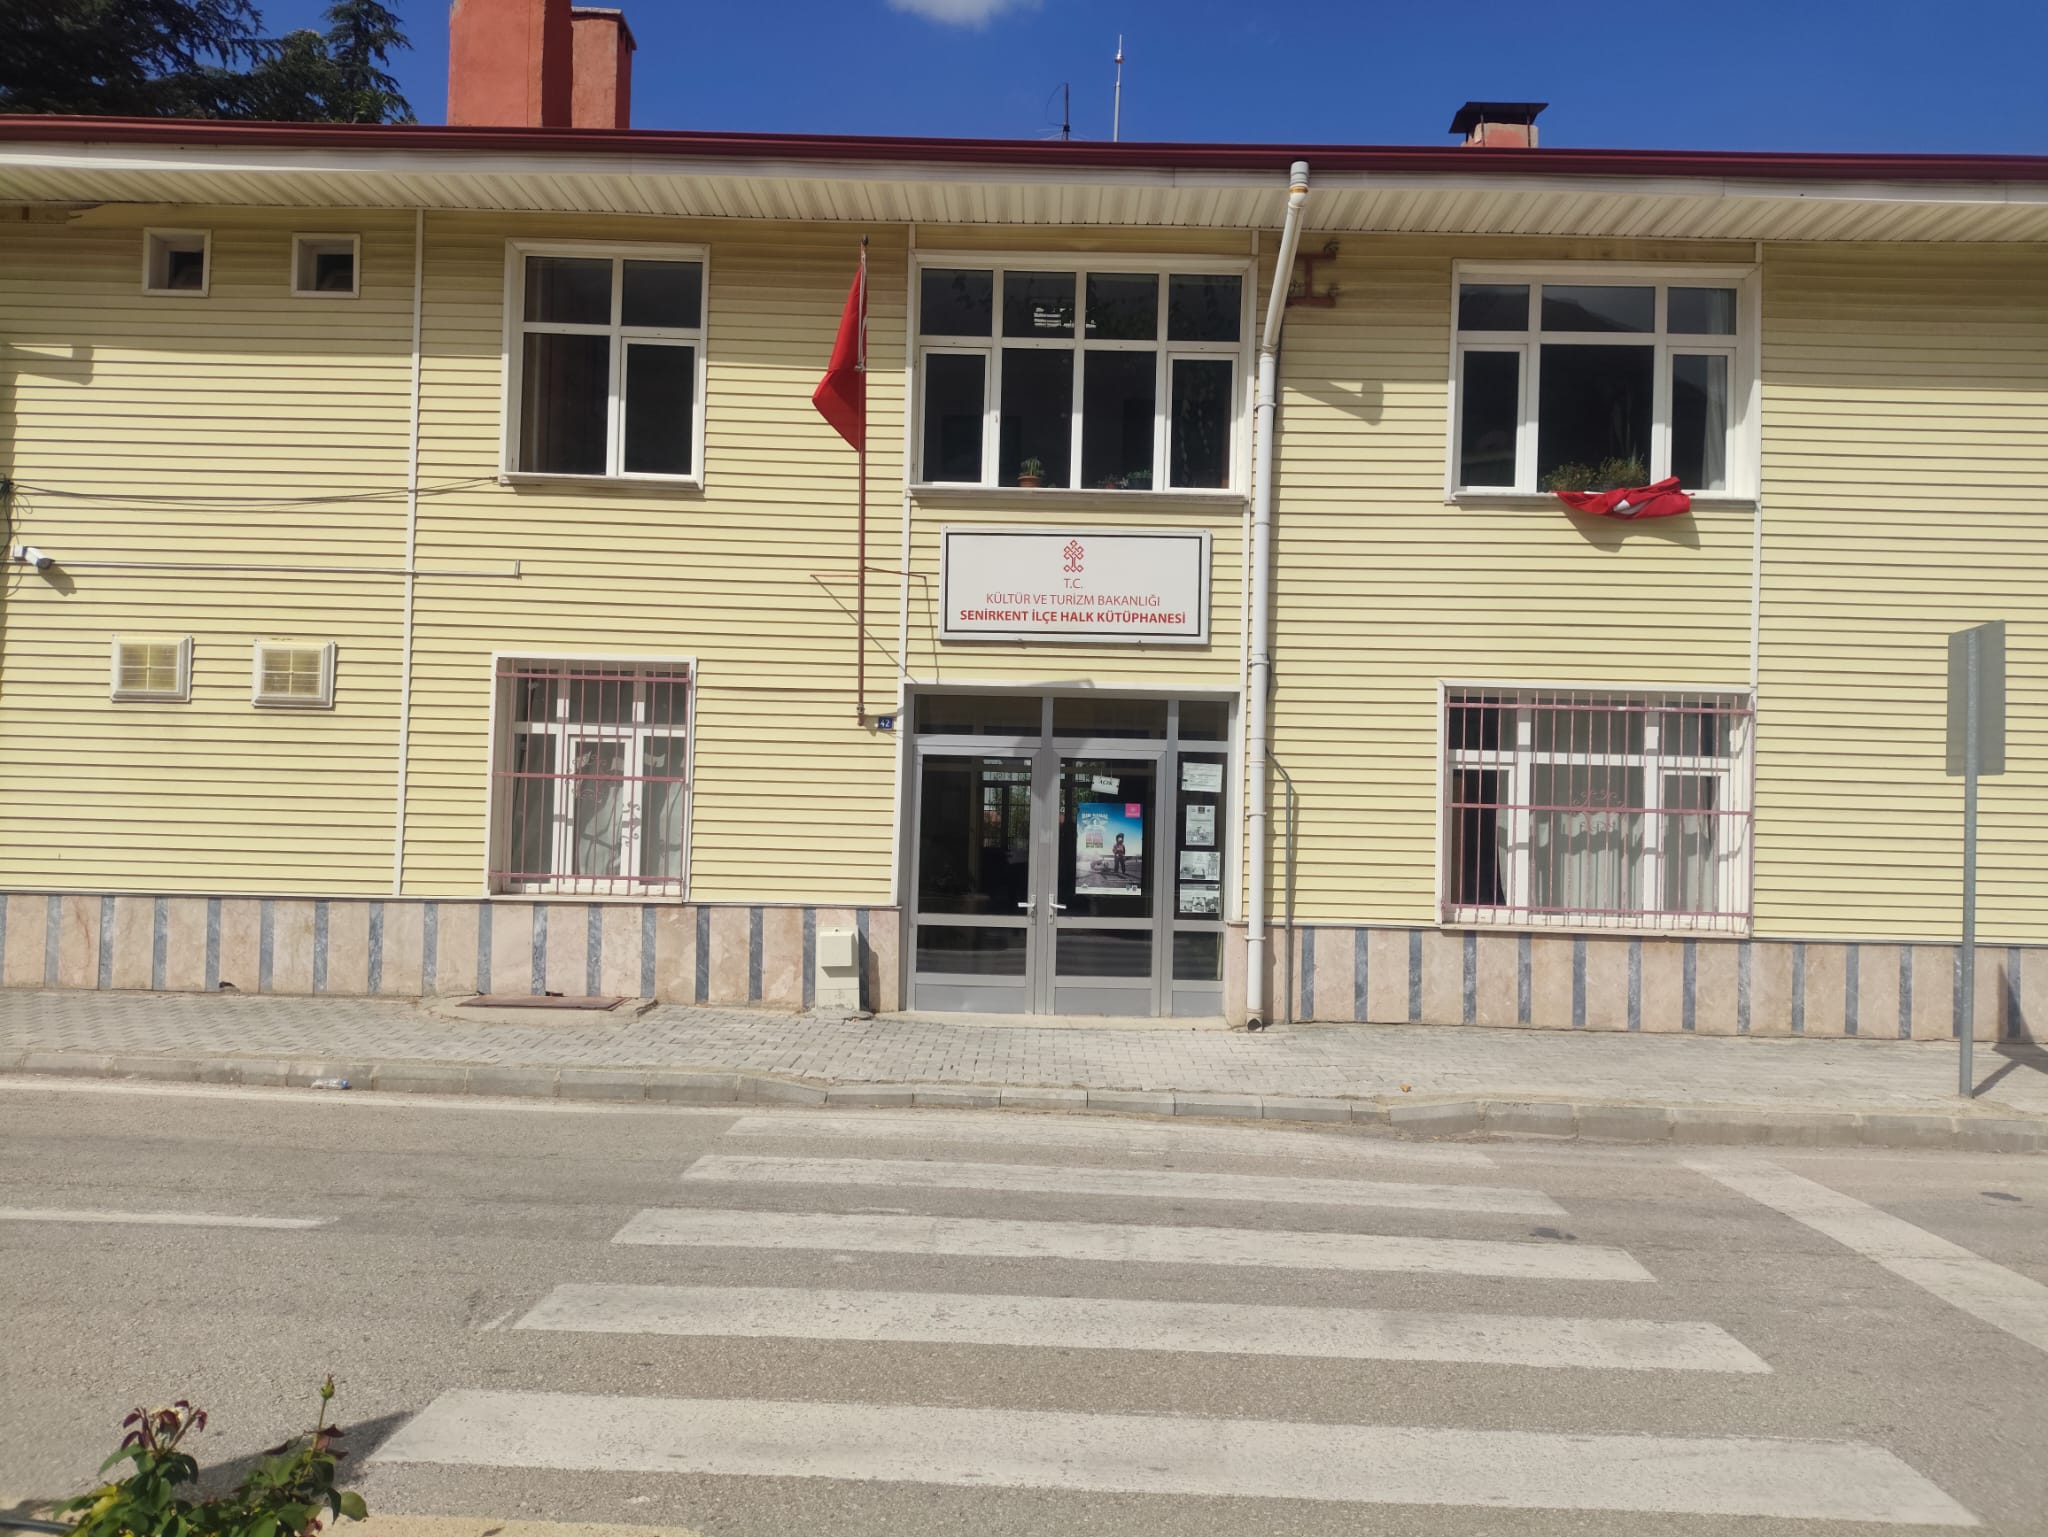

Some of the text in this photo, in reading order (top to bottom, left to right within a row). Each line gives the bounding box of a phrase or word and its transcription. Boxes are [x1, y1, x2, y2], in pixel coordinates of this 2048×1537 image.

[1064, 578, 1083, 589] T.C.
[986, 592, 1160, 607] KÜLTÜR VE TURİZM BAKANLIĞI
[960, 609, 1186, 624] SENİRKENT İLÇE HALK KÜTÜPHANESİ
[880, 719, 890, 728] 42
